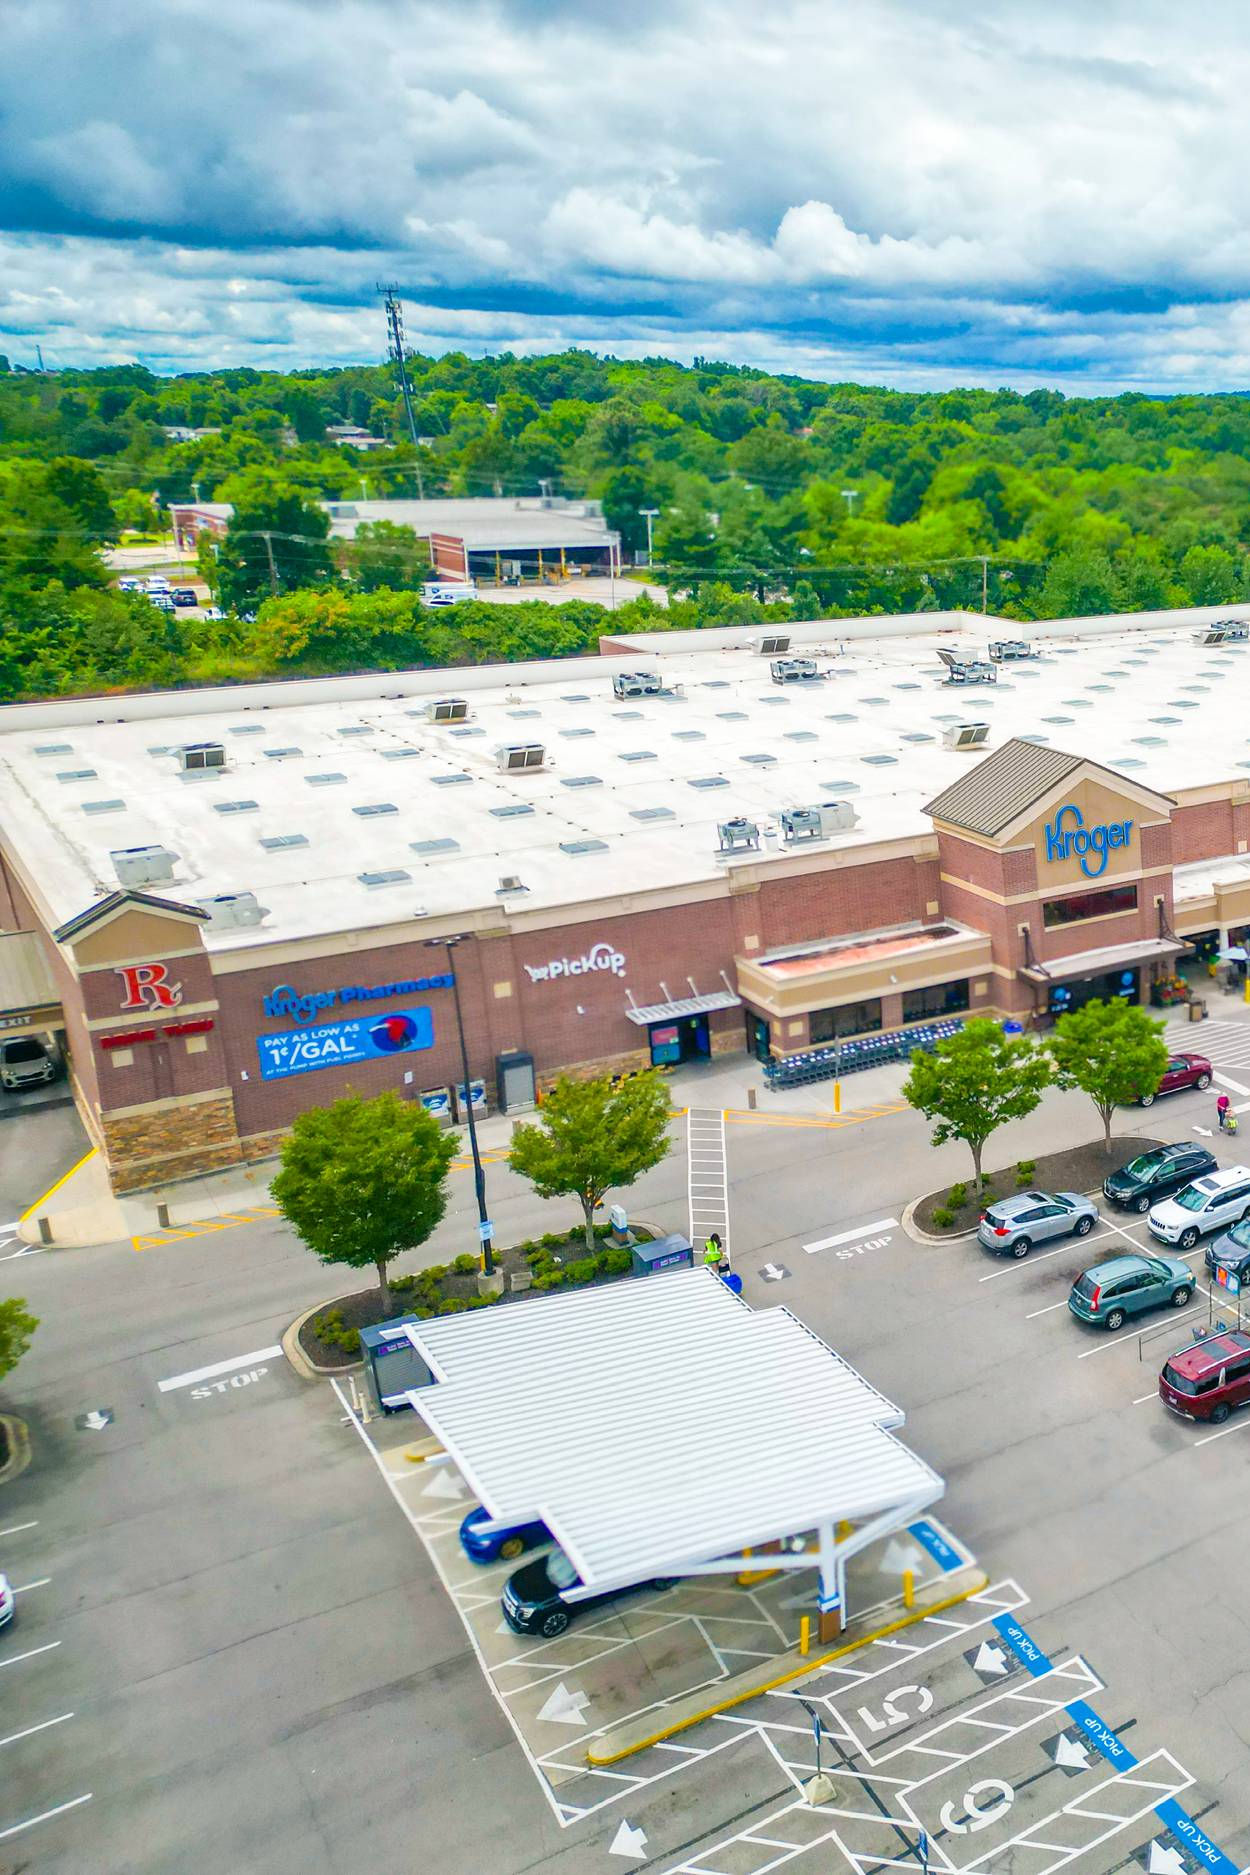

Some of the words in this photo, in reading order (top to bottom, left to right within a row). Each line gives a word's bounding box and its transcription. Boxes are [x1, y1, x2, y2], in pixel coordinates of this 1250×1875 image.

[1044, 804, 1134, 878] Kroger
[263, 984, 337, 1025] Kroger
[339, 972, 456, 1004] Pharmacy
[264, 1037, 288, 1048] PAY
[292, 1031, 308, 1042] AS
[311, 1025, 341, 1039] LOW
[343, 1023, 360, 1032] AS
[835, 1236, 893, 1260] STOP
[190, 1367, 269, 1400] STOP
[1007, 1627, 1026, 1641] UP
[1017, 1639, 1041, 1662] PICK
[857, 1685, 934, 1732] 5
[1084, 1718, 1102, 1733] UP
[1098, 1731, 1124, 1757] PICK
[1177, 1819, 1196, 1836] UP
[1192, 1834, 1222, 1864] PICK
